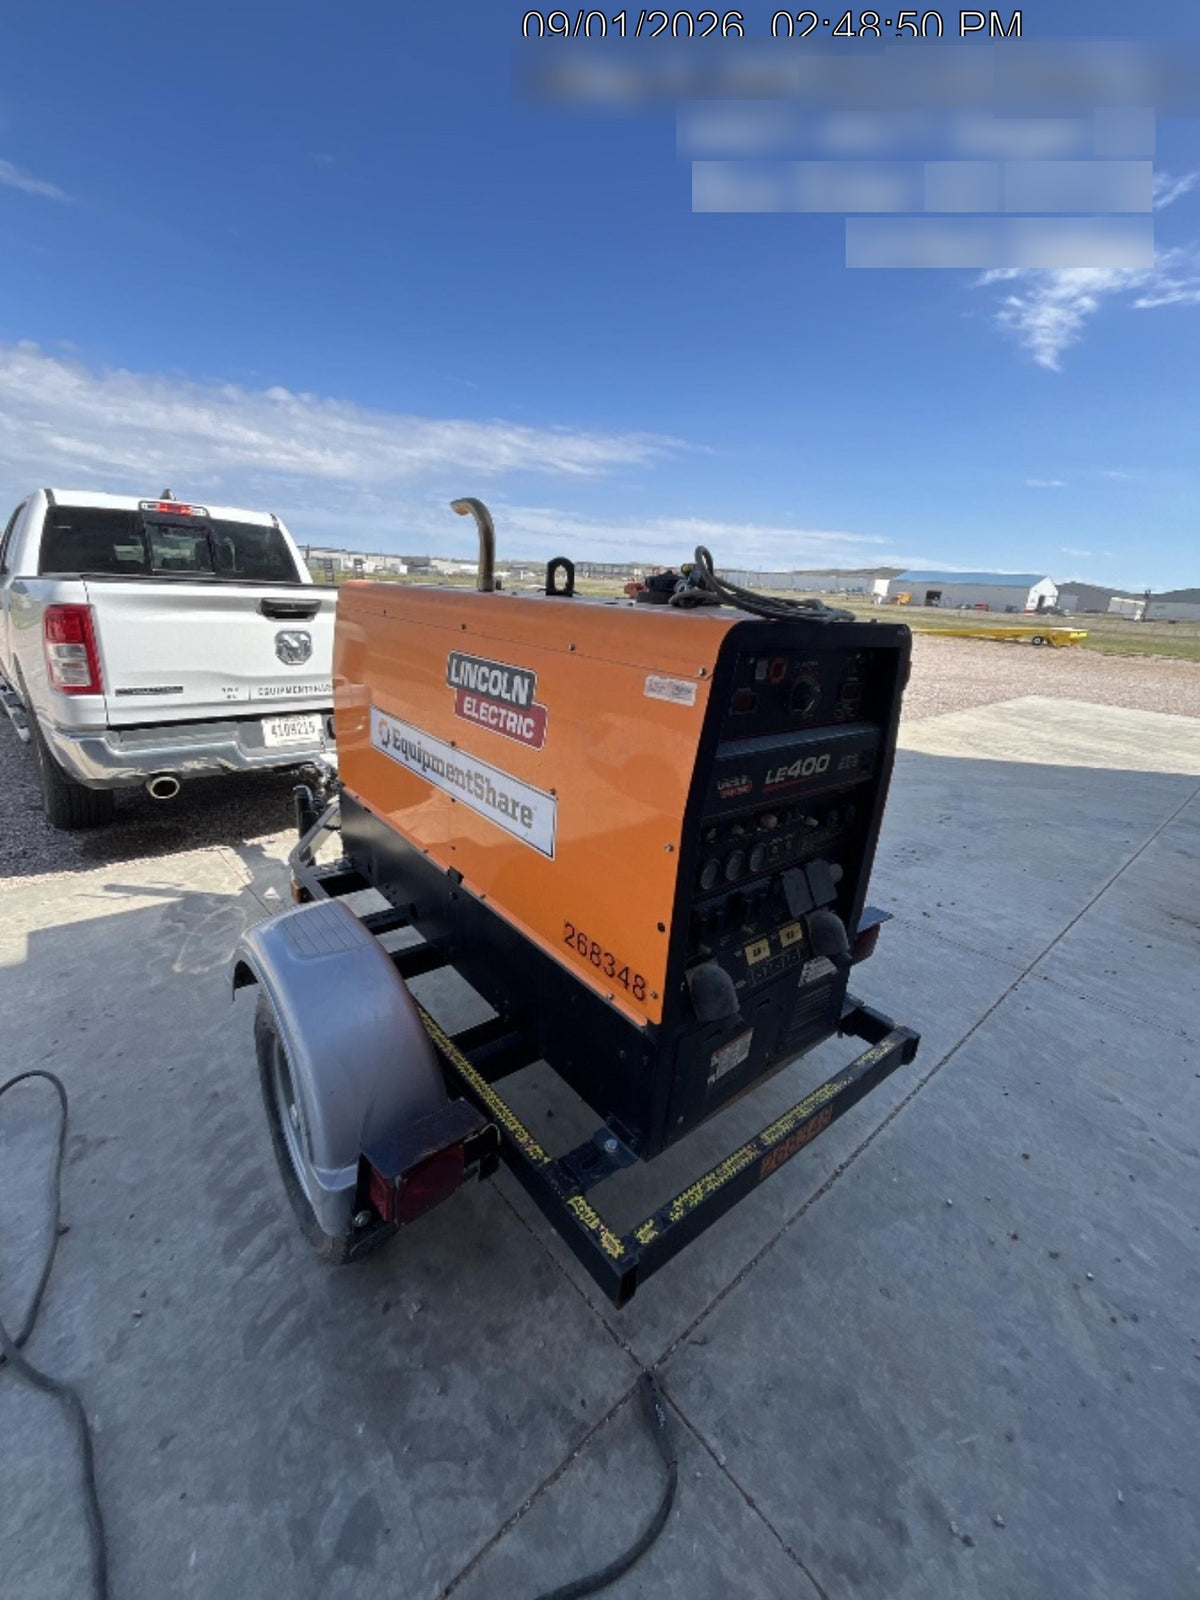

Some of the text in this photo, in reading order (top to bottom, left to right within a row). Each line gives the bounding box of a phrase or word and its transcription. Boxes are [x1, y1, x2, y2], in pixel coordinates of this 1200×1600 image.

[450, 657, 531, 705] LINCOLN
[463, 695, 535, 739] ELECTRIC
[391, 727, 534, 830] EquipmentShare
[765, 753, 831, 785] LE400
[564, 922, 647, 1002] 268348
